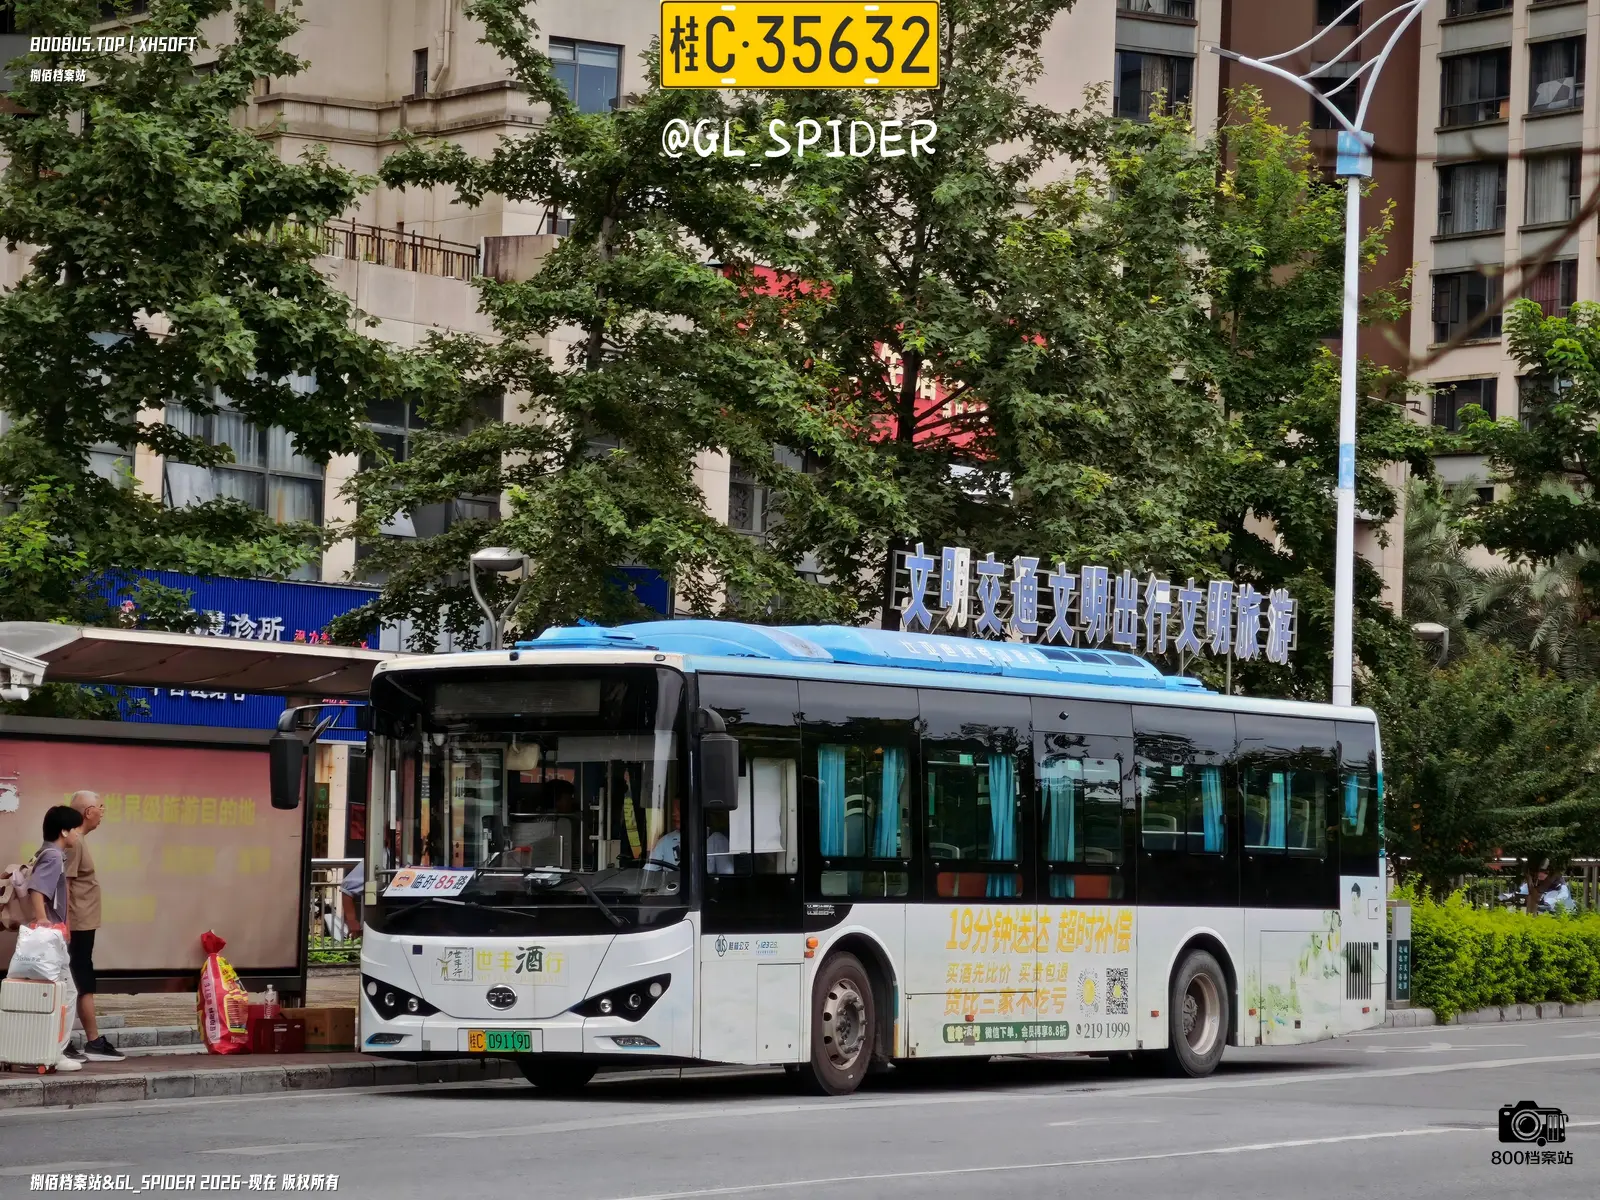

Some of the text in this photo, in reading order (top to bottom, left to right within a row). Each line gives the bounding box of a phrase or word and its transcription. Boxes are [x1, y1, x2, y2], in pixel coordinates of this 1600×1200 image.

[900, 542, 1297, 666] 文明交通文明出行文明旅游
[64, 792, 256, 826] 世界级旅游目的地
[411, 873, 468, 890] 临时85路
[945, 907, 1133, 954] 19分钟送达 超时补偿
[476, 946, 564, 974] 世丰酒行
[945, 962, 1069, 984] 买酒先比价 买贵包退
[943, 986, 1068, 1017] 货比三家不吃亏
[1084, 1022, 1130, 1039] 219 1999
